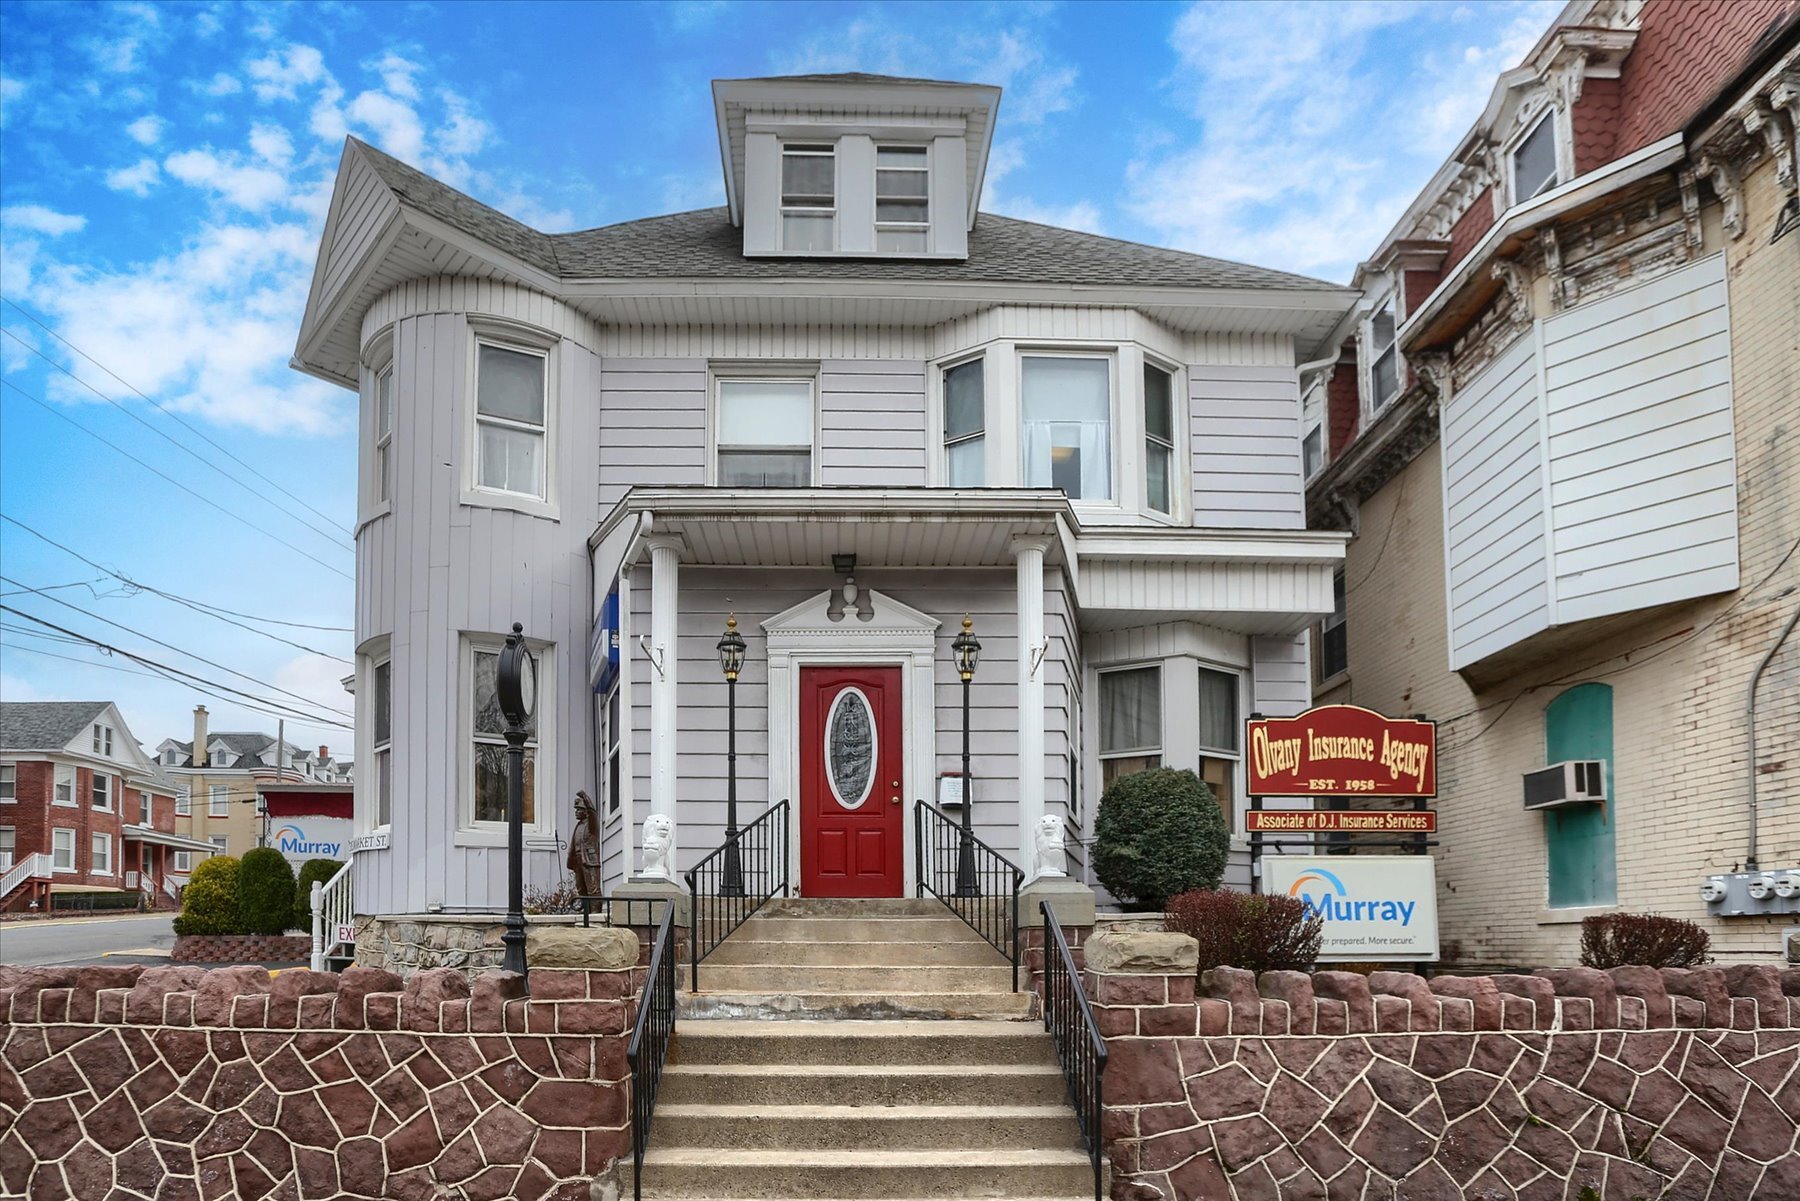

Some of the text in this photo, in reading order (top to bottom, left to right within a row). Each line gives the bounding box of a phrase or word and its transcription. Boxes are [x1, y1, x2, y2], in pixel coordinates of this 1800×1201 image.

[1253, 726, 1429, 793] Olvany Insurance Agency
[1309, 779, 1376, 791] EST. 1958
[1256, 813, 1428, 829] Associate of D.J. Insurance Services
[281, 838, 340, 857] Murray
[1302, 893, 1415, 927] Murray
[1331, 936, 1367, 946] prepared.
[1368, 936, 1388, 945] More
